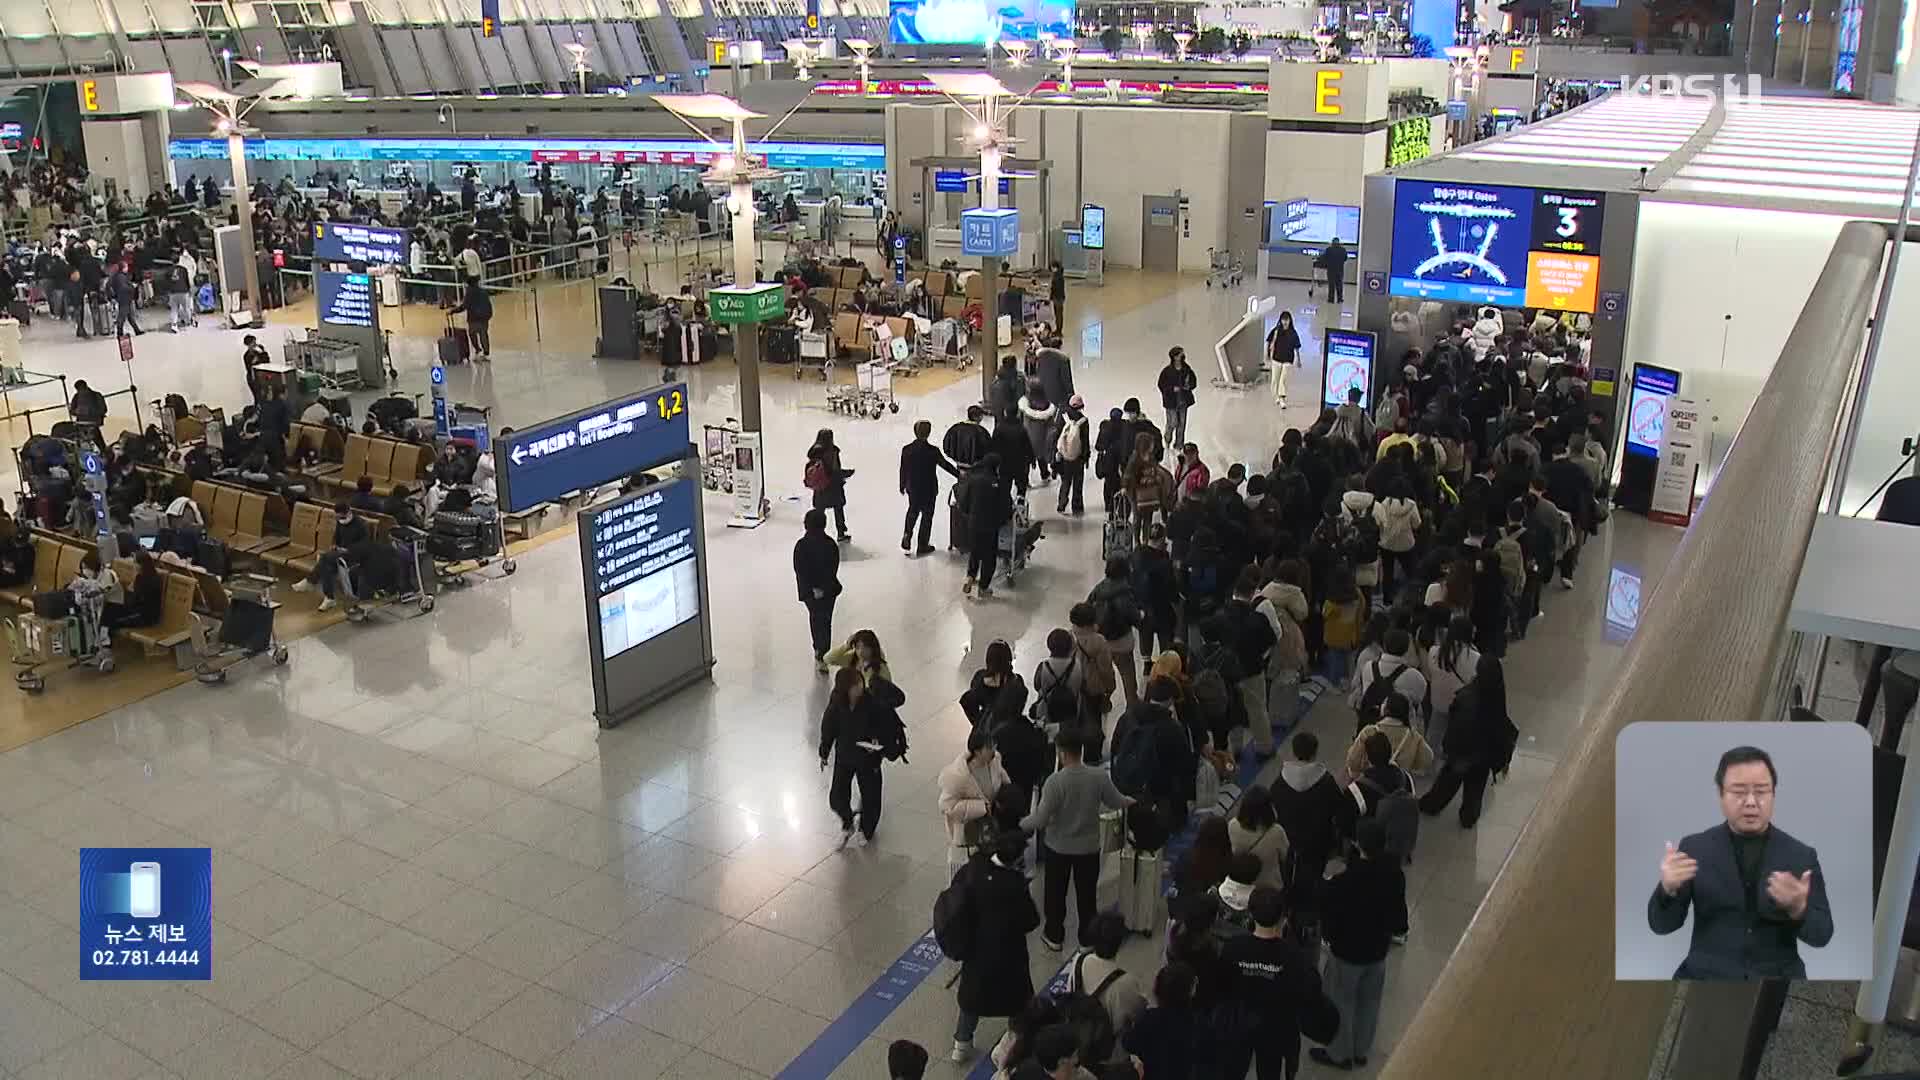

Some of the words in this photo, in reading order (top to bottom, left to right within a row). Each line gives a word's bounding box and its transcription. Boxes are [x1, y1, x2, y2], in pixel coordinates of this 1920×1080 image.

[484, 17, 493, 38] F
[807, 15, 817, 28] G
[715, 42, 725, 63] F
[1511, 49, 1524, 71] F
[83, 80, 98, 110] E
[1316, 70, 1343, 114] E
[970, 223, 991, 237] 카트
[1555, 207, 1577, 238] 3
[729, 300, 745, 308] AED
[657, 391, 682, 420] 1,2
[597, 421, 633, 441] Boarding
